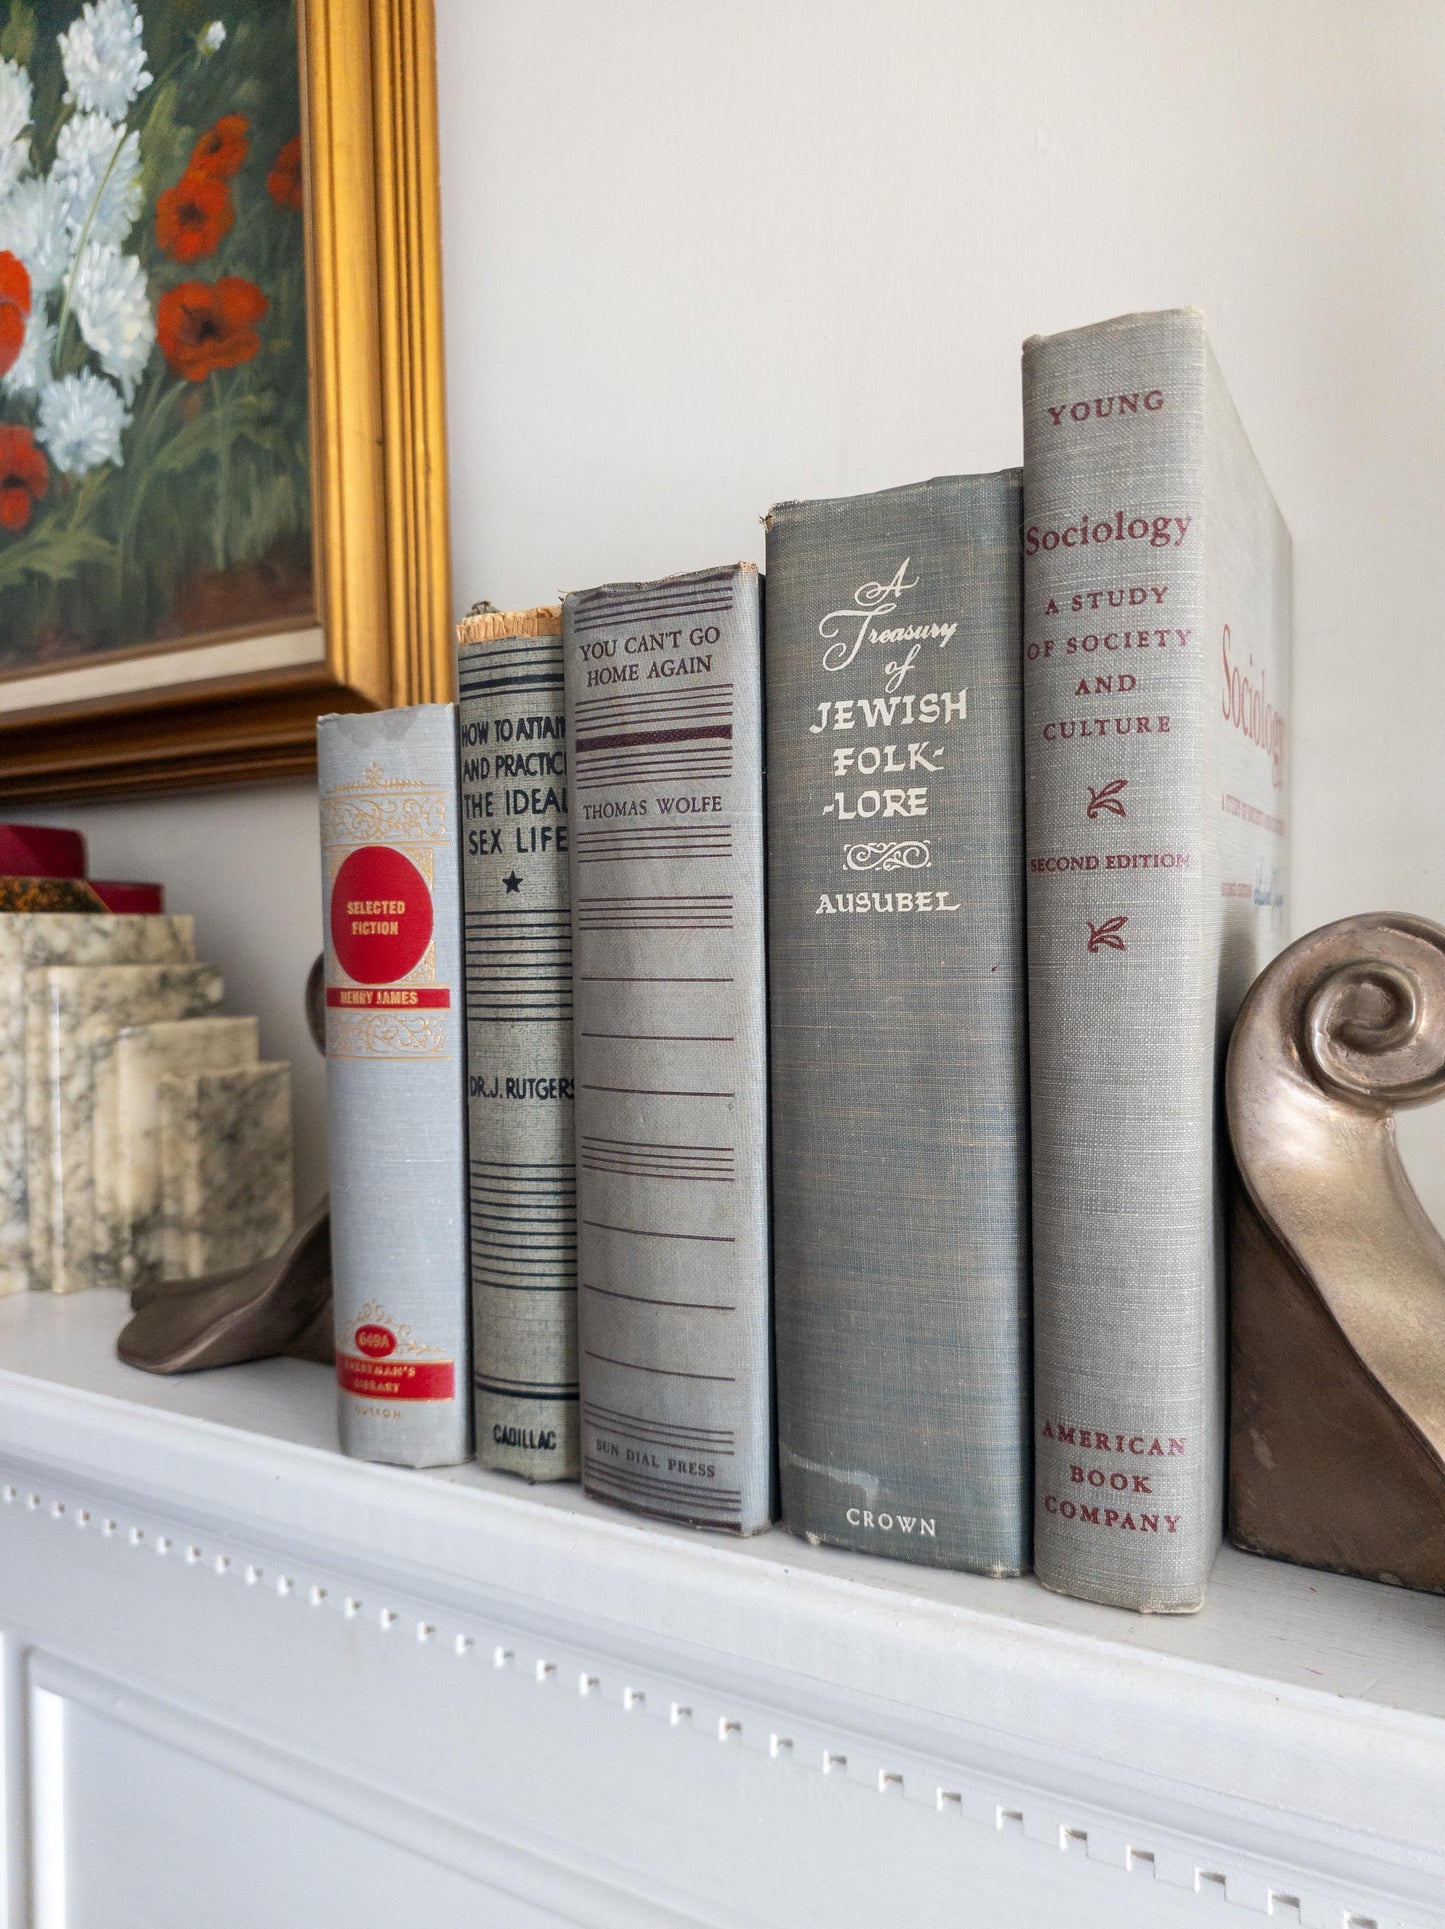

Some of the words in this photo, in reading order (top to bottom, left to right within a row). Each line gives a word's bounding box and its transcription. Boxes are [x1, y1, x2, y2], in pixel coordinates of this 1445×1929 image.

[1047, 390, 1165, 426] YOUNG
[1025, 511, 1192, 556] Sociology
[854, 557, 920, 606] A
[1045, 599, 1059, 615] A
[1072, 586, 1169, 612] STUDY
[579, 639, 617, 662] YOU
[624, 631, 682, 654] CAN'T
[689, 626, 721, 645] GO
[818, 602, 958, 672] Treasury
[1026, 640, 1055, 661] OF
[1066, 629, 1192, 655] SOCIETY
[587, 664, 639, 687] HOME
[646, 654, 712, 679] AGAIN
[885, 644, 921, 693] of
[1074, 674, 1137, 697] AND
[809, 687, 969, 733] JEWISH
[462, 720, 489, 748] HOW
[495, 718, 513, 743] TO
[1043, 716, 1171, 741] CULTURE
[463, 757, 490, 782] AND
[496, 751, 567, 779] PRACTIC
[464, 792, 494, 819] THE
[506, 787, 569, 816] IDEAL
[583, 800, 648, 821] THOMAS
[656, 796, 722, 815] WOLFE
[469, 828, 502, 855] SEX
[517, 826, 569, 853] LIFE
[1030, 856, 1099, 872] SECOND
[1105, 854, 1191, 870] EDITION
[347, 900, 406, 915] SELECTED
[815, 891, 961, 915] AUSUBEL
[352, 921, 399, 935] FICTION
[340, 991, 373, 1005] HENRY
[376, 991, 418, 1005] JAMES
[493, 1424, 557, 1451] CADILLAC
[1041, 1420, 1186, 1457] AMERICAN
[595, 1439, 619, 1457] SUN
[626, 1449, 660, 1468] DIAL
[667, 1457, 716, 1478] PRESS
[1069, 1464, 1152, 1494] BOOK
[846, 1507, 937, 1537] CROWN
[1044, 1495, 1181, 1533] COMPANY
